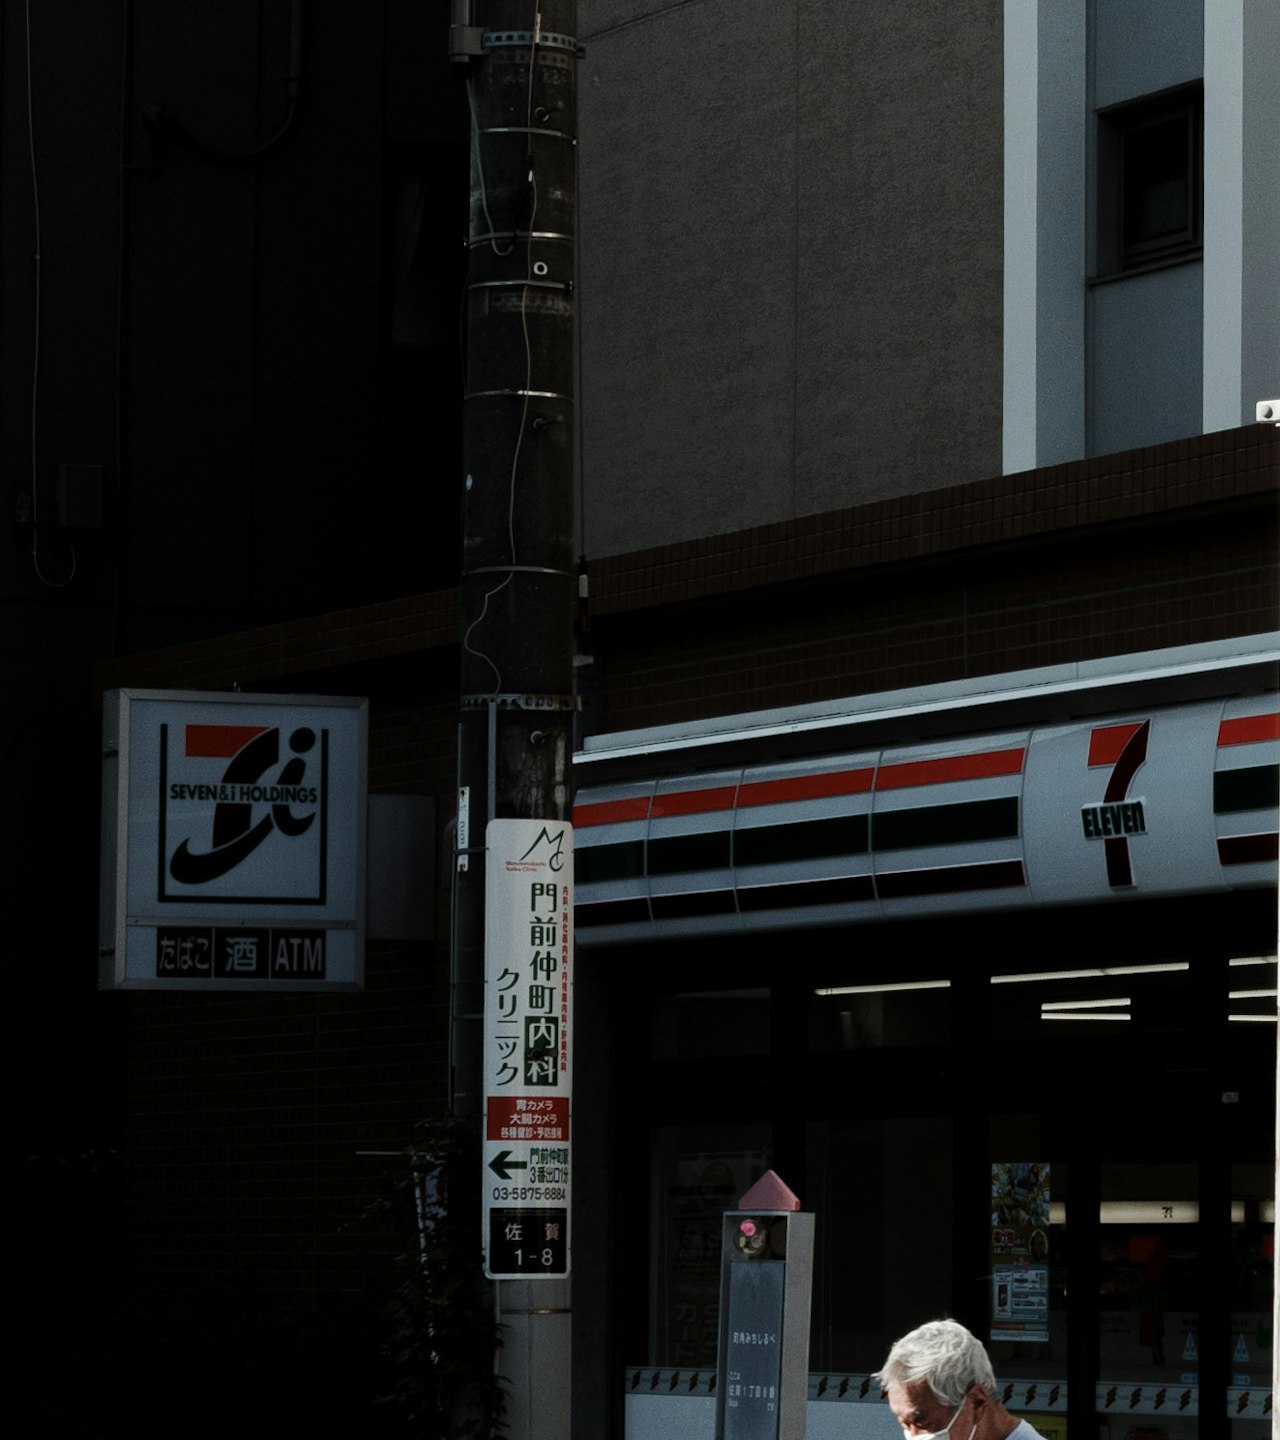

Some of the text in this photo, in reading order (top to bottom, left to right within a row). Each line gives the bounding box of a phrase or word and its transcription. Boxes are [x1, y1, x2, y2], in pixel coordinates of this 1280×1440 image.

[239, 784, 318, 804] HOLDINGS
[158, 935, 323, 973] たばこ 酒 ATM
[495, 968, 521, 1086] クリニック
[516, 1099, 554, 1111] 胃カメラ
[509, 1113, 558, 1125] 大腸カメラ
[493, 1187, 566, 1201] 03-5875-8884
[513, 1248, 554, 1266] 1-8
